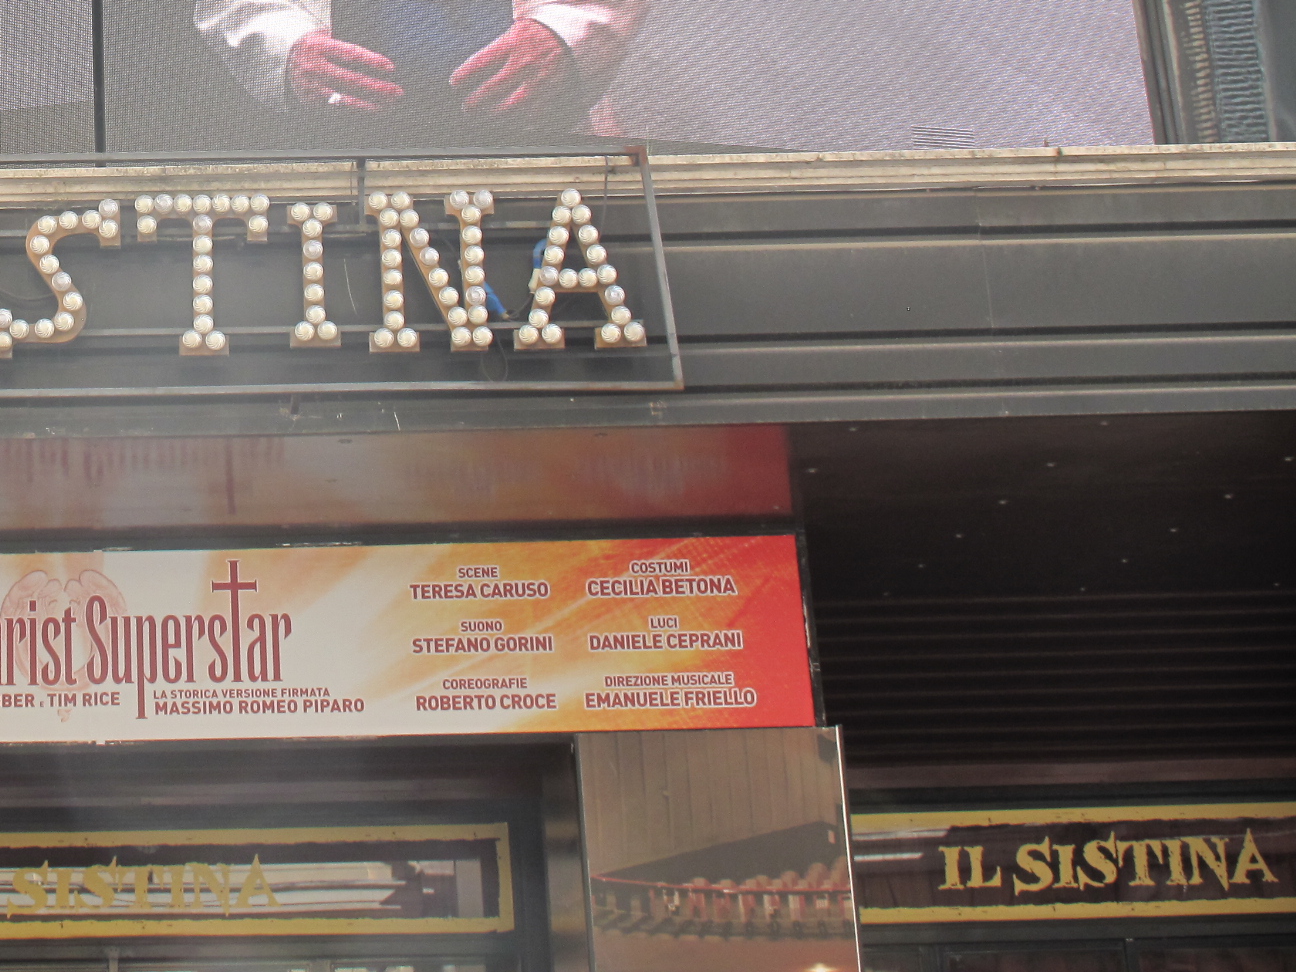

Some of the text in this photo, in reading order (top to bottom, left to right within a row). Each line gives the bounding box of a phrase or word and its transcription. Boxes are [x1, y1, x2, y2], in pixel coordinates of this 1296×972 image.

[458, 566, 498, 579] SCENE
[630, 560, 689, 574] COSTUMI
[410, 581, 549, 600] TERESA CARUSO
[587, 577, 737, 597] CECILIA BETONA
[460, 620, 503, 632] SUONO
[649, 617, 678, 629] LUCI
[85, 559, 292, 719] Superstar
[412, 635, 553, 654] STEFANO GORINI
[589, 631, 743, 651] DANIELE CEPRANI
[442, 677, 527, 690] COREOGRAFIE
[604, 673, 734, 687] DIREZIONE MUSICALE
[47, 693, 78, 708] TIM
[82, 692, 120, 707] RICE
[153, 687, 330, 700] LA STORICA VERSIONE FIRMATA
[584, 688, 756, 709] EMANUELE FRIELLO
[154, 698, 365, 716] MASSIMO ROMEO PIPARO
[416, 694, 557, 712] ROBERTO CROCE
[938, 828, 1279, 896] IL SISTINA
[6, 853, 282, 917] SISTINA
